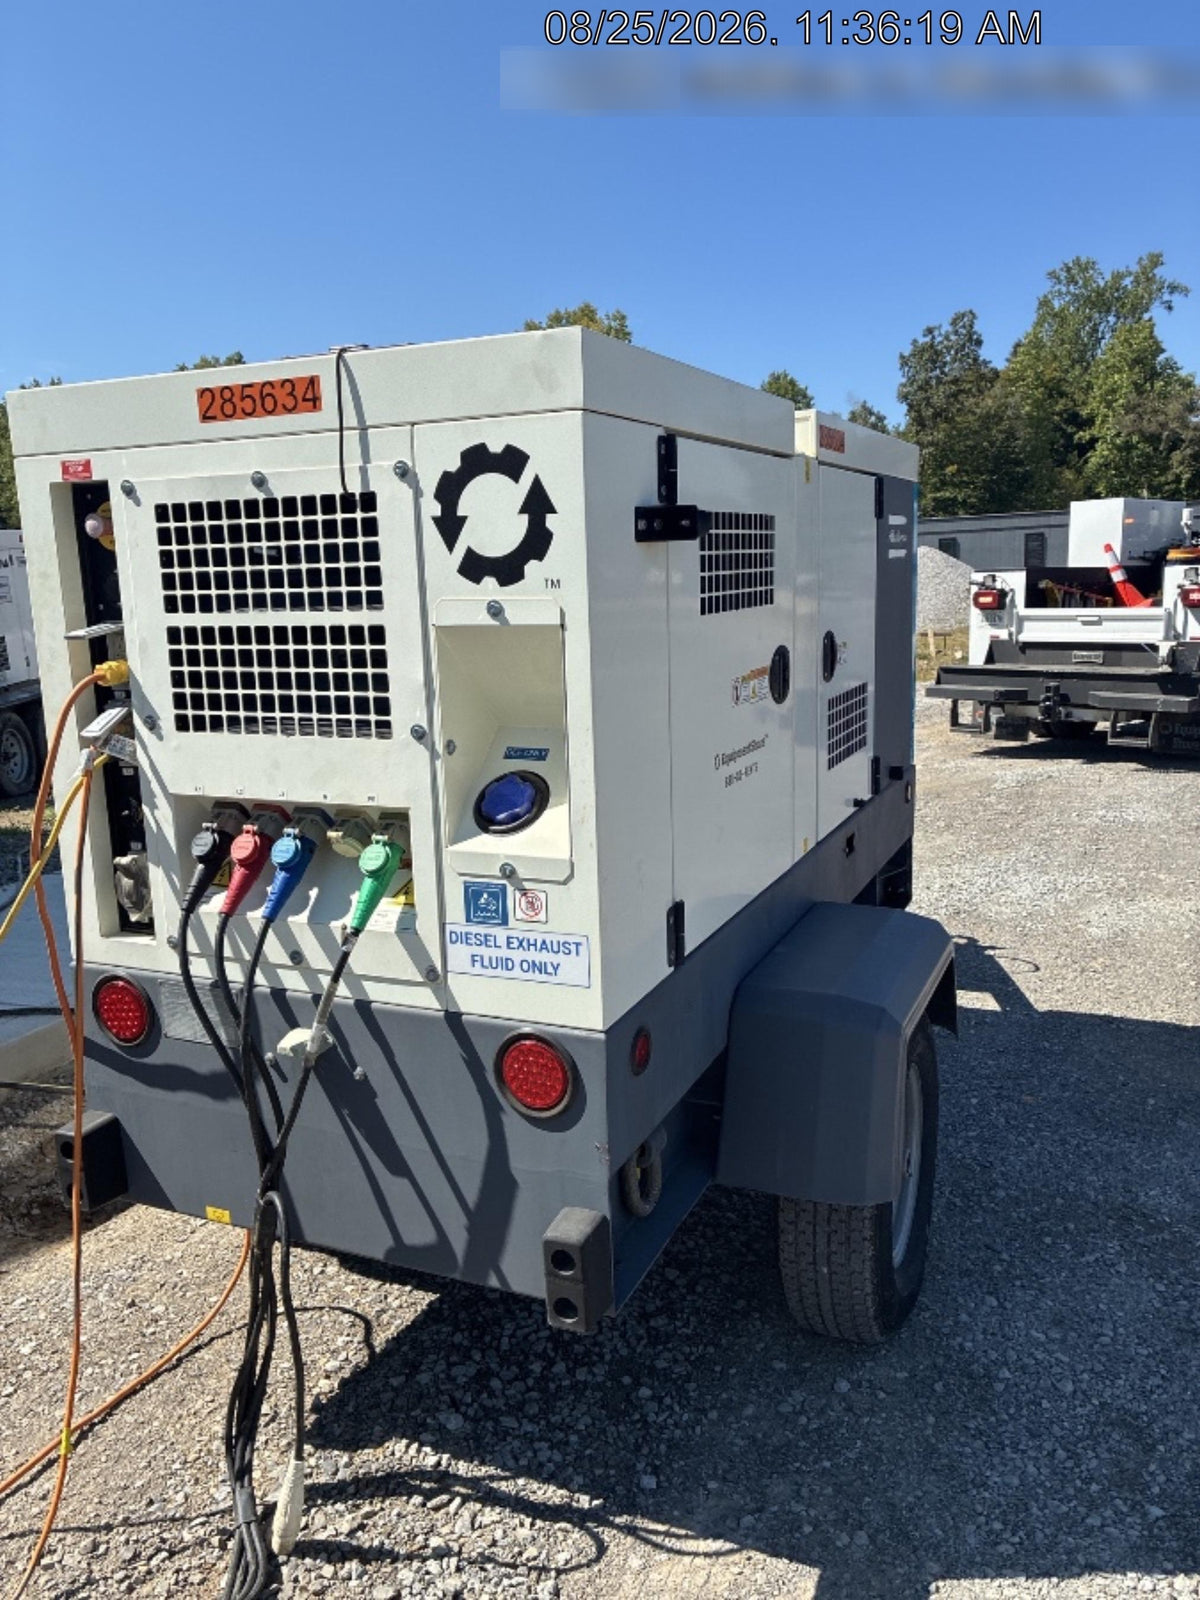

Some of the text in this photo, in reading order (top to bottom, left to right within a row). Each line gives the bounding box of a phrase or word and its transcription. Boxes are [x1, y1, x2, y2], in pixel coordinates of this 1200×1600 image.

[200, 376, 320, 420] 285634
[449, 931, 583, 957] DIESEL EXHAUST
[470, 954, 561, 977] FLUID ONLY
